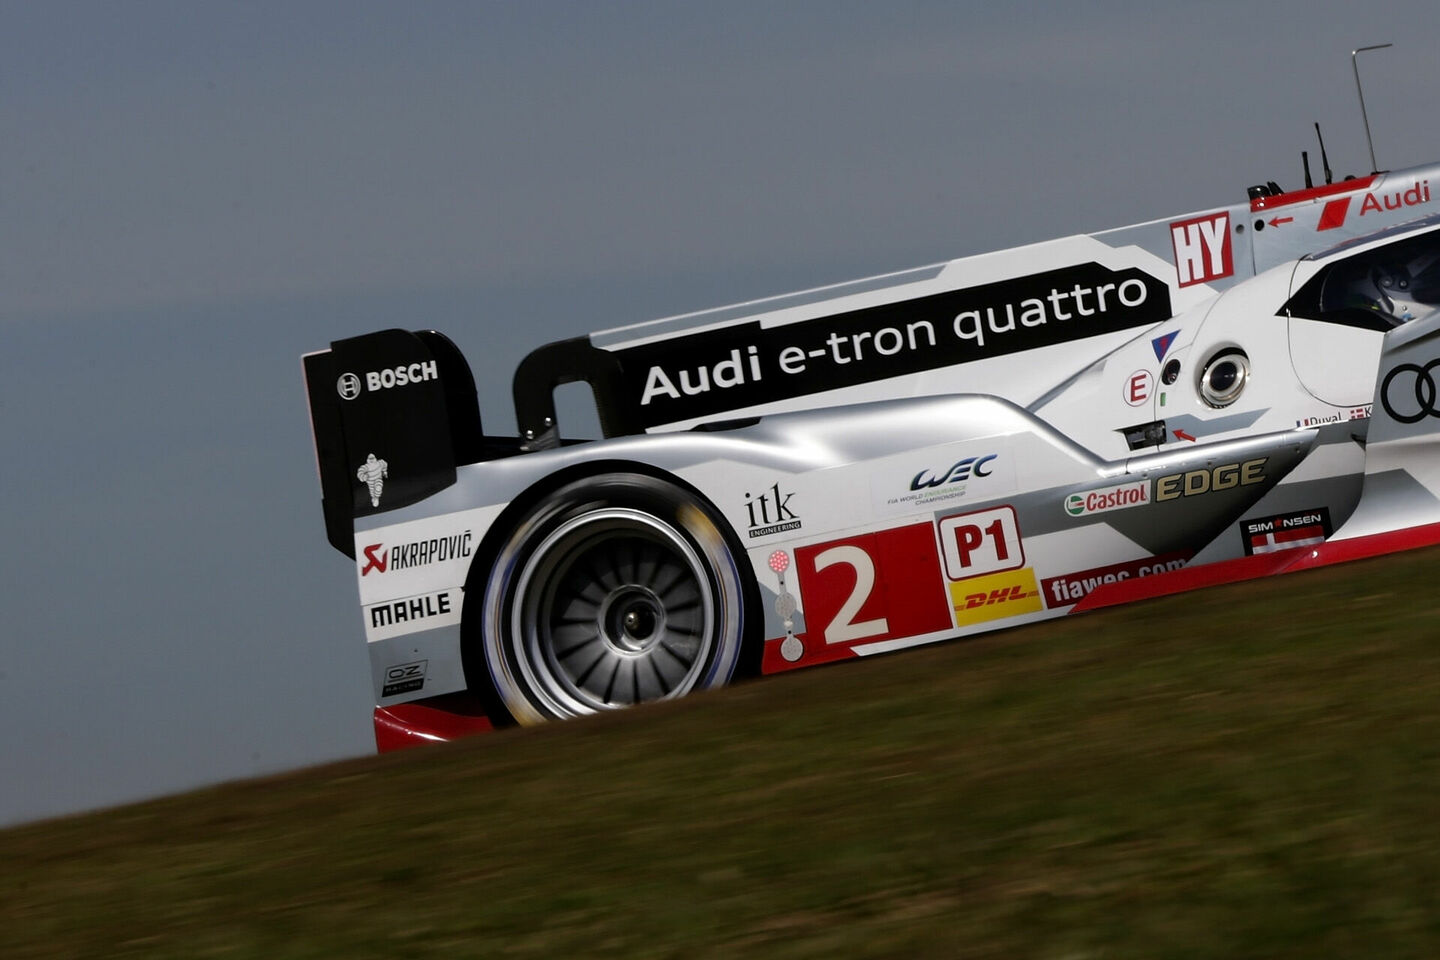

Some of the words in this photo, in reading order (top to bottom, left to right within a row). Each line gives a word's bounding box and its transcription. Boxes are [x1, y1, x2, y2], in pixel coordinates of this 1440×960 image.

[1360, 179, 1430, 216] Audi
[1172, 217, 1229, 284] HY
[640, 345, 762, 405] Audi
[779, 319, 937, 374] e-tron
[953, 278, 1147, 346] quattro
[366, 360, 438, 391] BOSCH
[1130, 374, 1147, 402] E
[910, 454, 998, 491] WEC
[1085, 484, 1148, 512] Castrol
[1155, 457, 1270, 503] EDGE
[743, 482, 800, 528] itk
[900, 493, 923, 504] WORLD
[915, 491, 967, 506] CHAMPIONSHIP
[750, 521, 801, 538] ENGINEERING
[953, 519, 1009, 569] P1
[813, 545, 889, 644] 2
[964, 585, 1027, 610] DHL
[1051, 557, 1188, 602] fiaweccom
[371, 593, 451, 628] MAHLE
[388, 664, 422, 679] OZ
